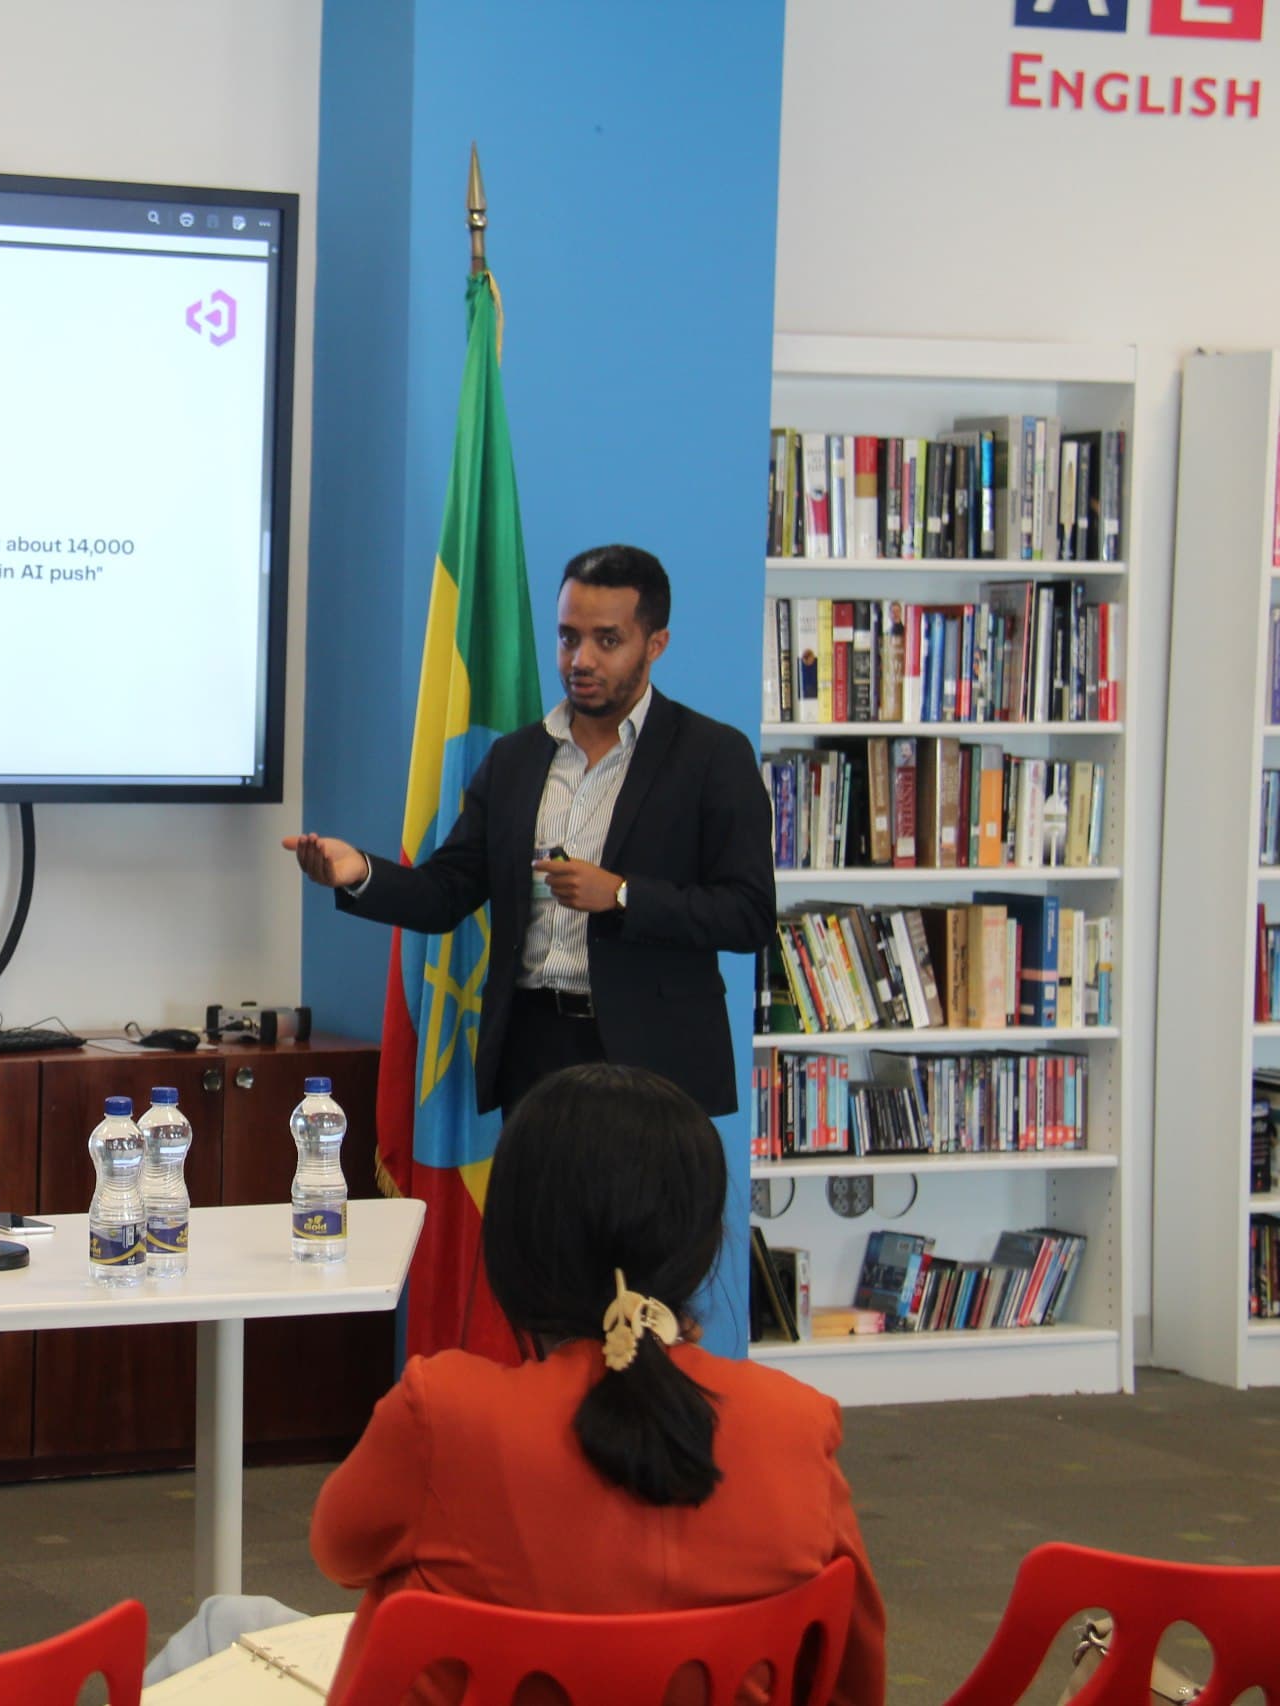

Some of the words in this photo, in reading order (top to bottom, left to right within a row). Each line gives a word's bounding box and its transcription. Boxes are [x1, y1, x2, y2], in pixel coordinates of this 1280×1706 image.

[1009, 52, 1261, 118] ENGLISH
[6, 536, 63, 554] about
[67, 538, 136, 558] 14,000
[20, 563, 45, 580] AI
